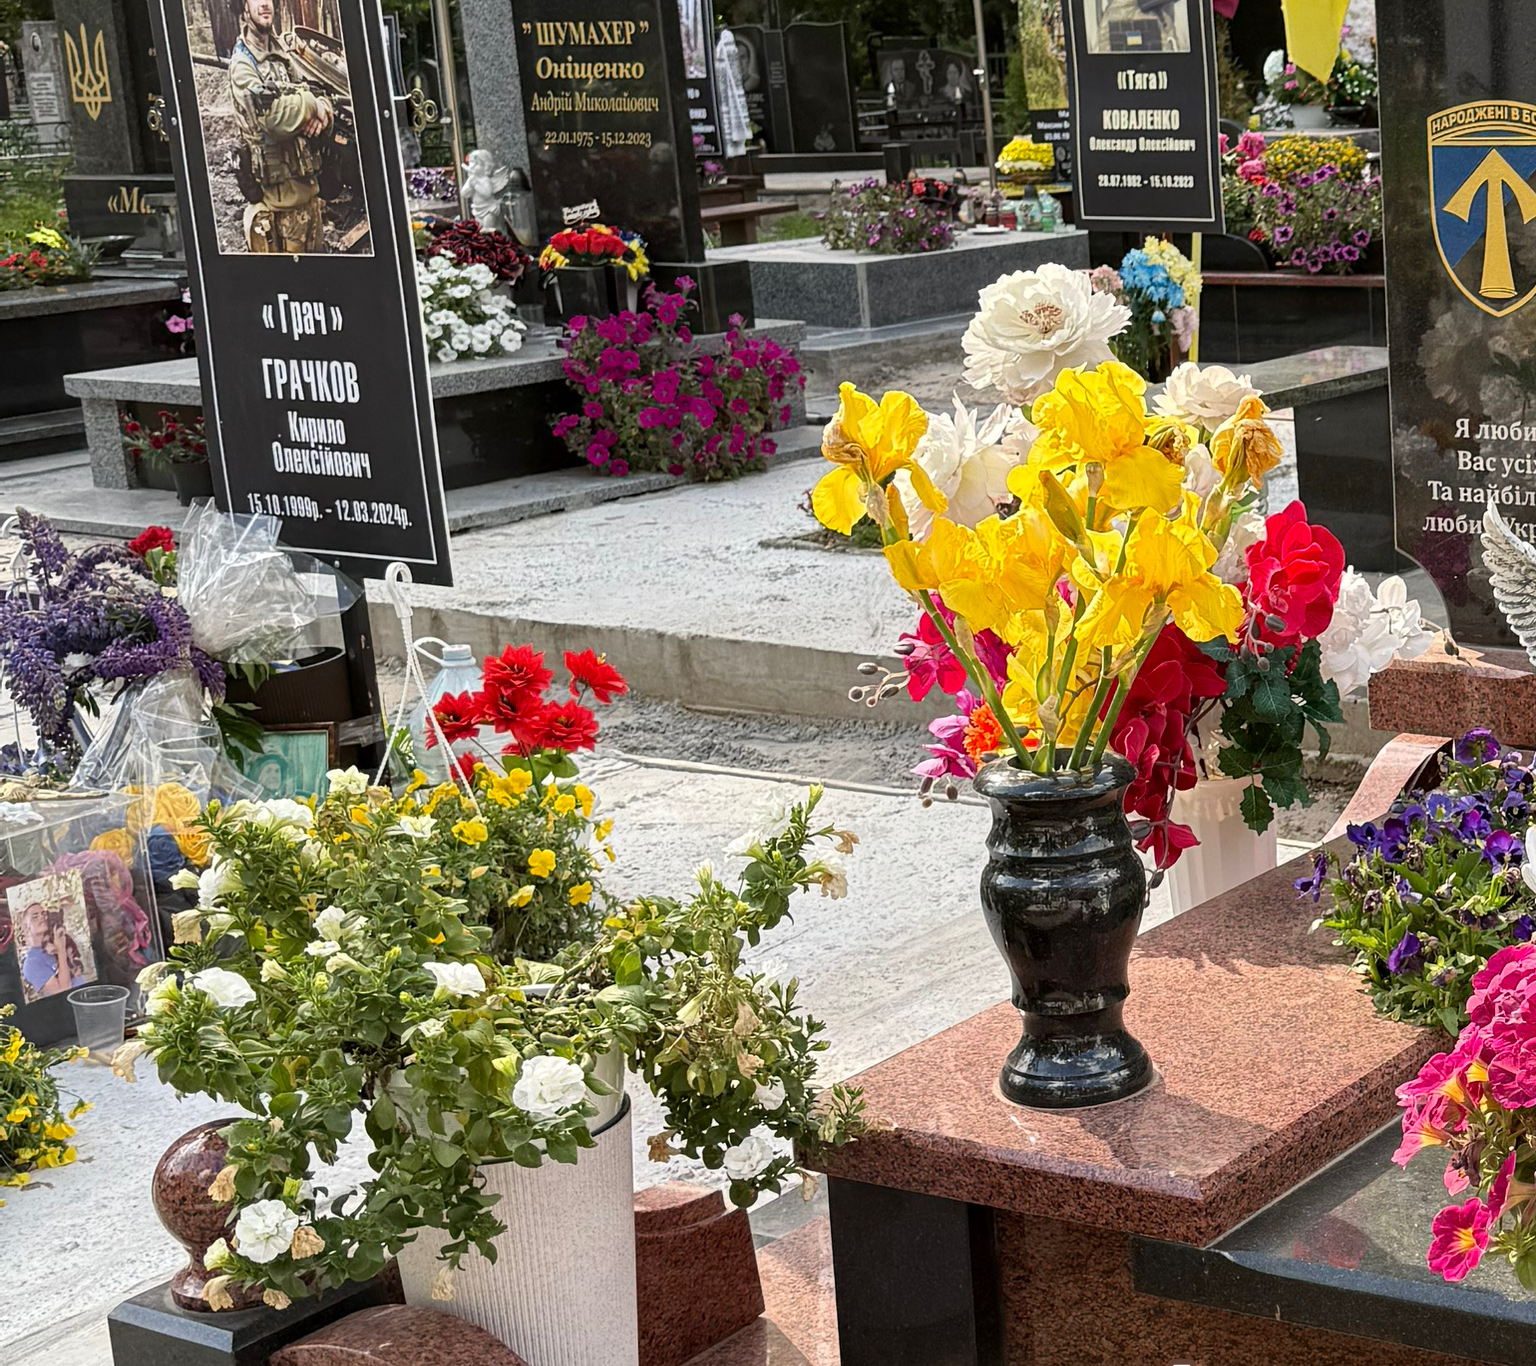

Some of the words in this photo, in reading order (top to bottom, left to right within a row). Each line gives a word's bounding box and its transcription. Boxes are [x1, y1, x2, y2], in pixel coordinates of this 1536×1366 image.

[536, 21, 636, 46] ШУМАХЕР
[536, 55, 644, 84] Оніщенко
[1117, 69, 1168, 90] «Тяга»
[531, 91, 572, 116] Андрій
[574, 92, 660, 113] Миколайович
[1102, 109, 1180, 130] КОВАЛЕНКО
[1432, 106, 1508, 133] НАРОДЖЕНІ
[1511, 107, 1520, 121] В
[544, 131, 594, 147] 22.01.1975
[601, 132, 651, 148] 15.12.2023
[261, 358, 360, 403] ГРАЧКОВ
[287, 410, 346, 447] Кирило
[1454, 418, 1470, 439] Я
[271, 441, 372, 479] Олексійович
[1457, 450, 1496, 472] Вас
[1427, 480, 1453, 501] Та
[335, 499, 413, 530] 12.03.2024р.
[1422, 514, 1482, 534] люби
